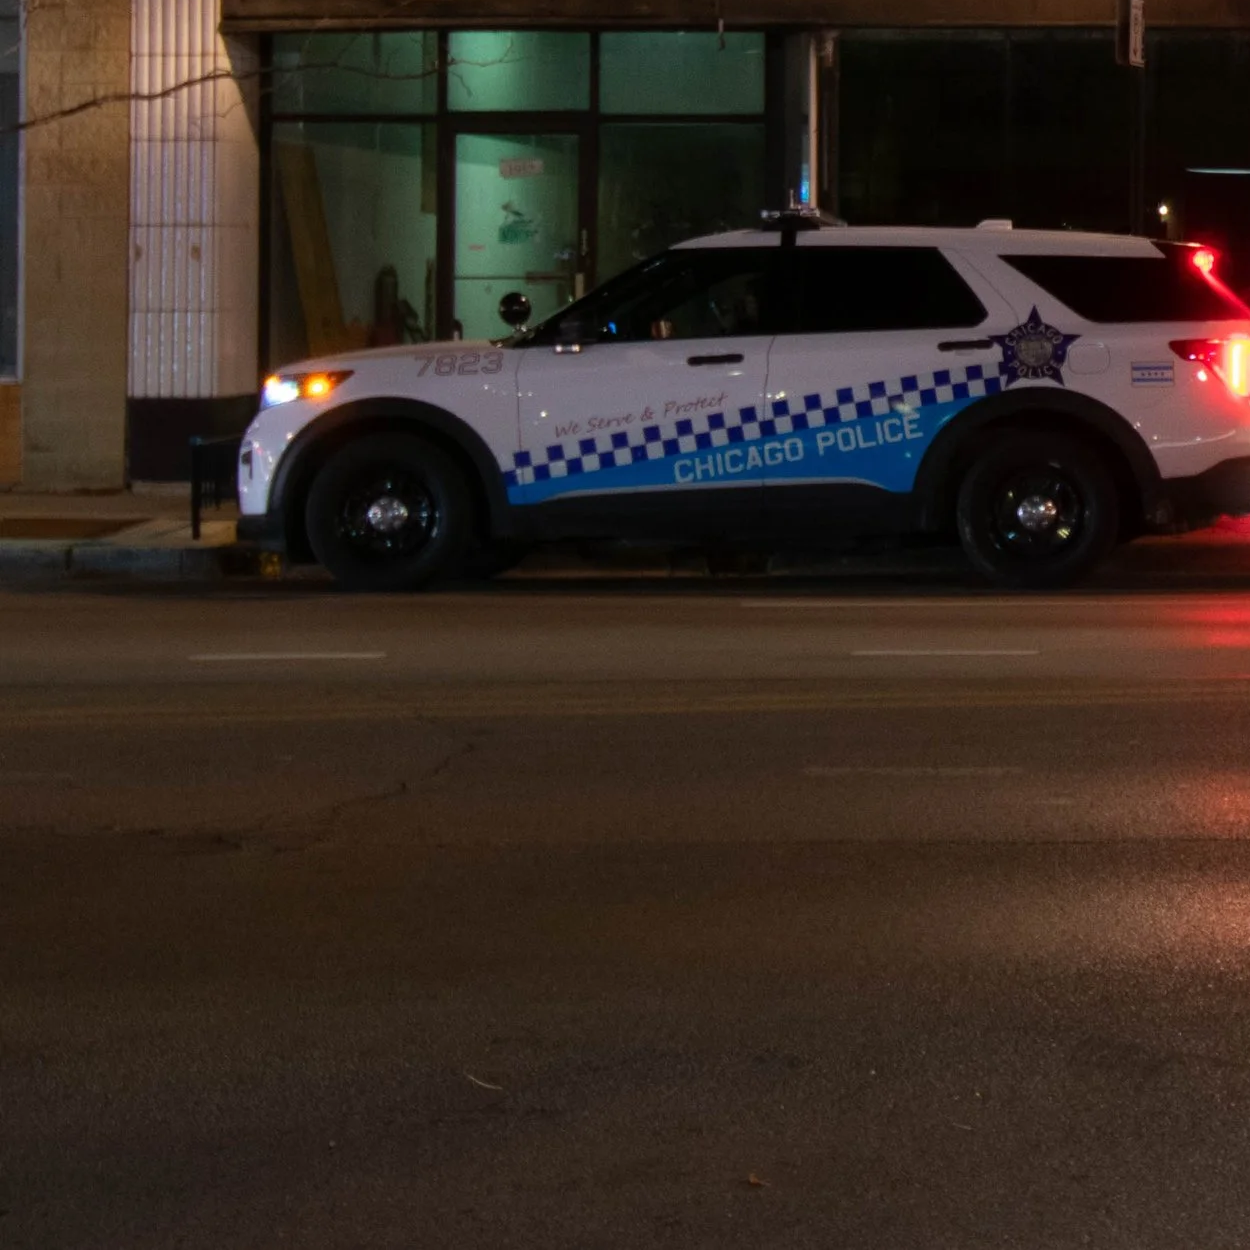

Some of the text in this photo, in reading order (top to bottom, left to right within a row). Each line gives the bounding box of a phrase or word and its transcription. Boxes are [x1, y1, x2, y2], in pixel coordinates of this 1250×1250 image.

[1004, 322, 1064, 347] CHICAGO
[414, 351, 504, 378] 7823
[554, 391, 729, 438] We Serve & Protect
[673, 411, 924, 484] CHICAGO POLICE
